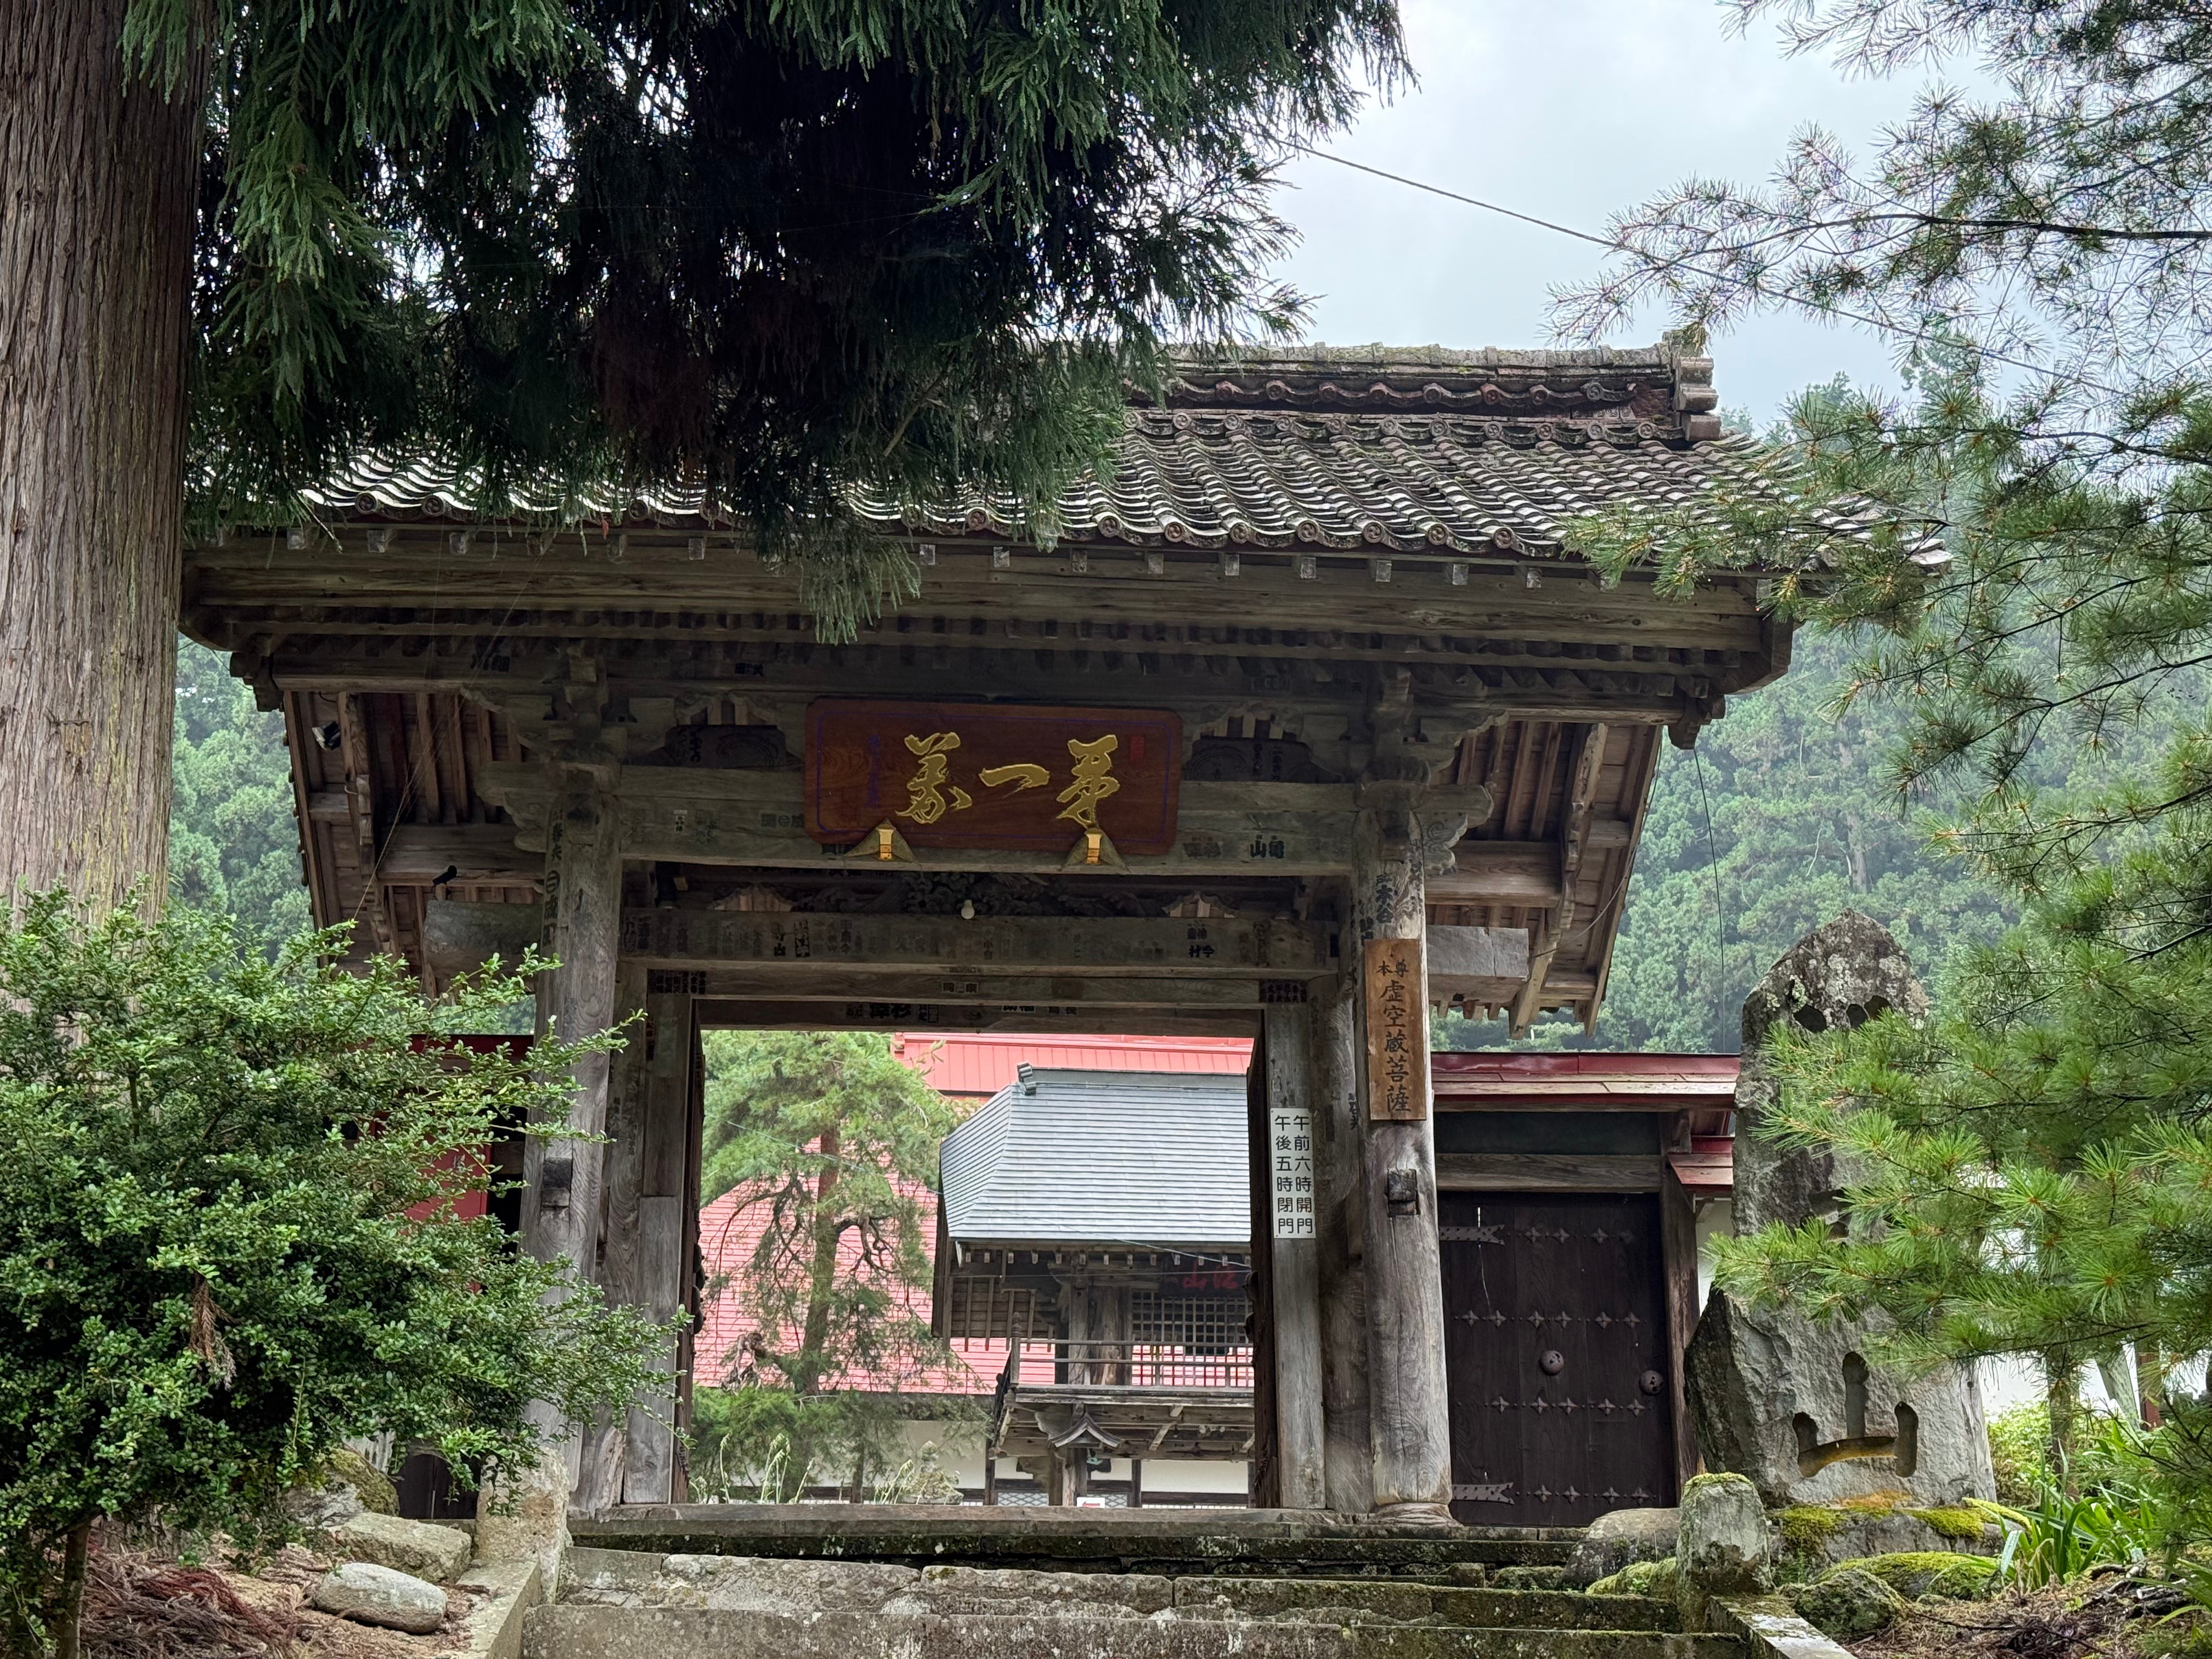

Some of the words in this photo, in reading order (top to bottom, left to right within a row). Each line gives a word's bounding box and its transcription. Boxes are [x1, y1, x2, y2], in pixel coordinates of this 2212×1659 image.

[1376, 958, 1409, 978] 本尊
[1379, 979, 1412, 1113] 虚空蔵菩薩
[1274, 1115, 1294, 1234] 午後五時閉門
[1293, 1115, 1313, 1234] 午前六時開門
